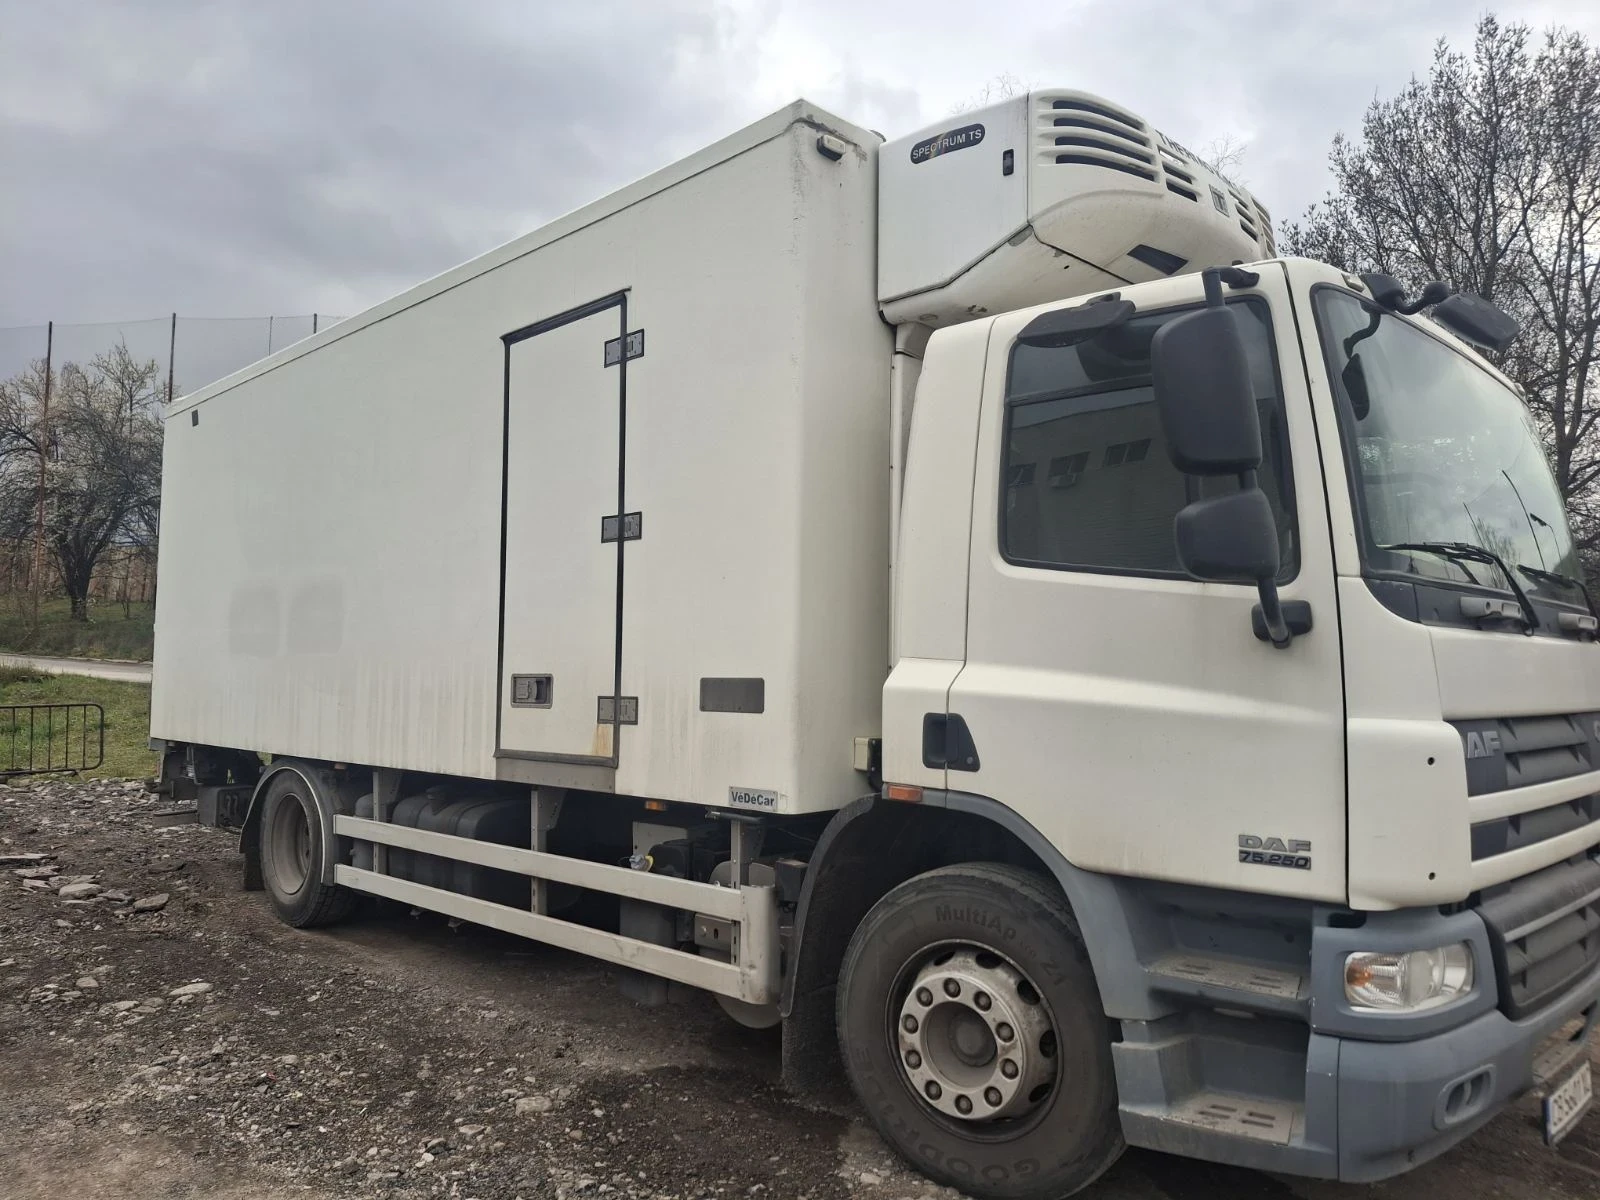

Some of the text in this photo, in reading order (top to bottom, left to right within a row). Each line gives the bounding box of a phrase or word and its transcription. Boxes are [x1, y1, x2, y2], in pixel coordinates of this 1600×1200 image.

[912, 129, 982, 159] SPECTRUM TS
[1467, 730, 1500, 759] AF
[1239, 834, 1311, 853] DAF
[1240, 851, 1310, 869] 75.250
